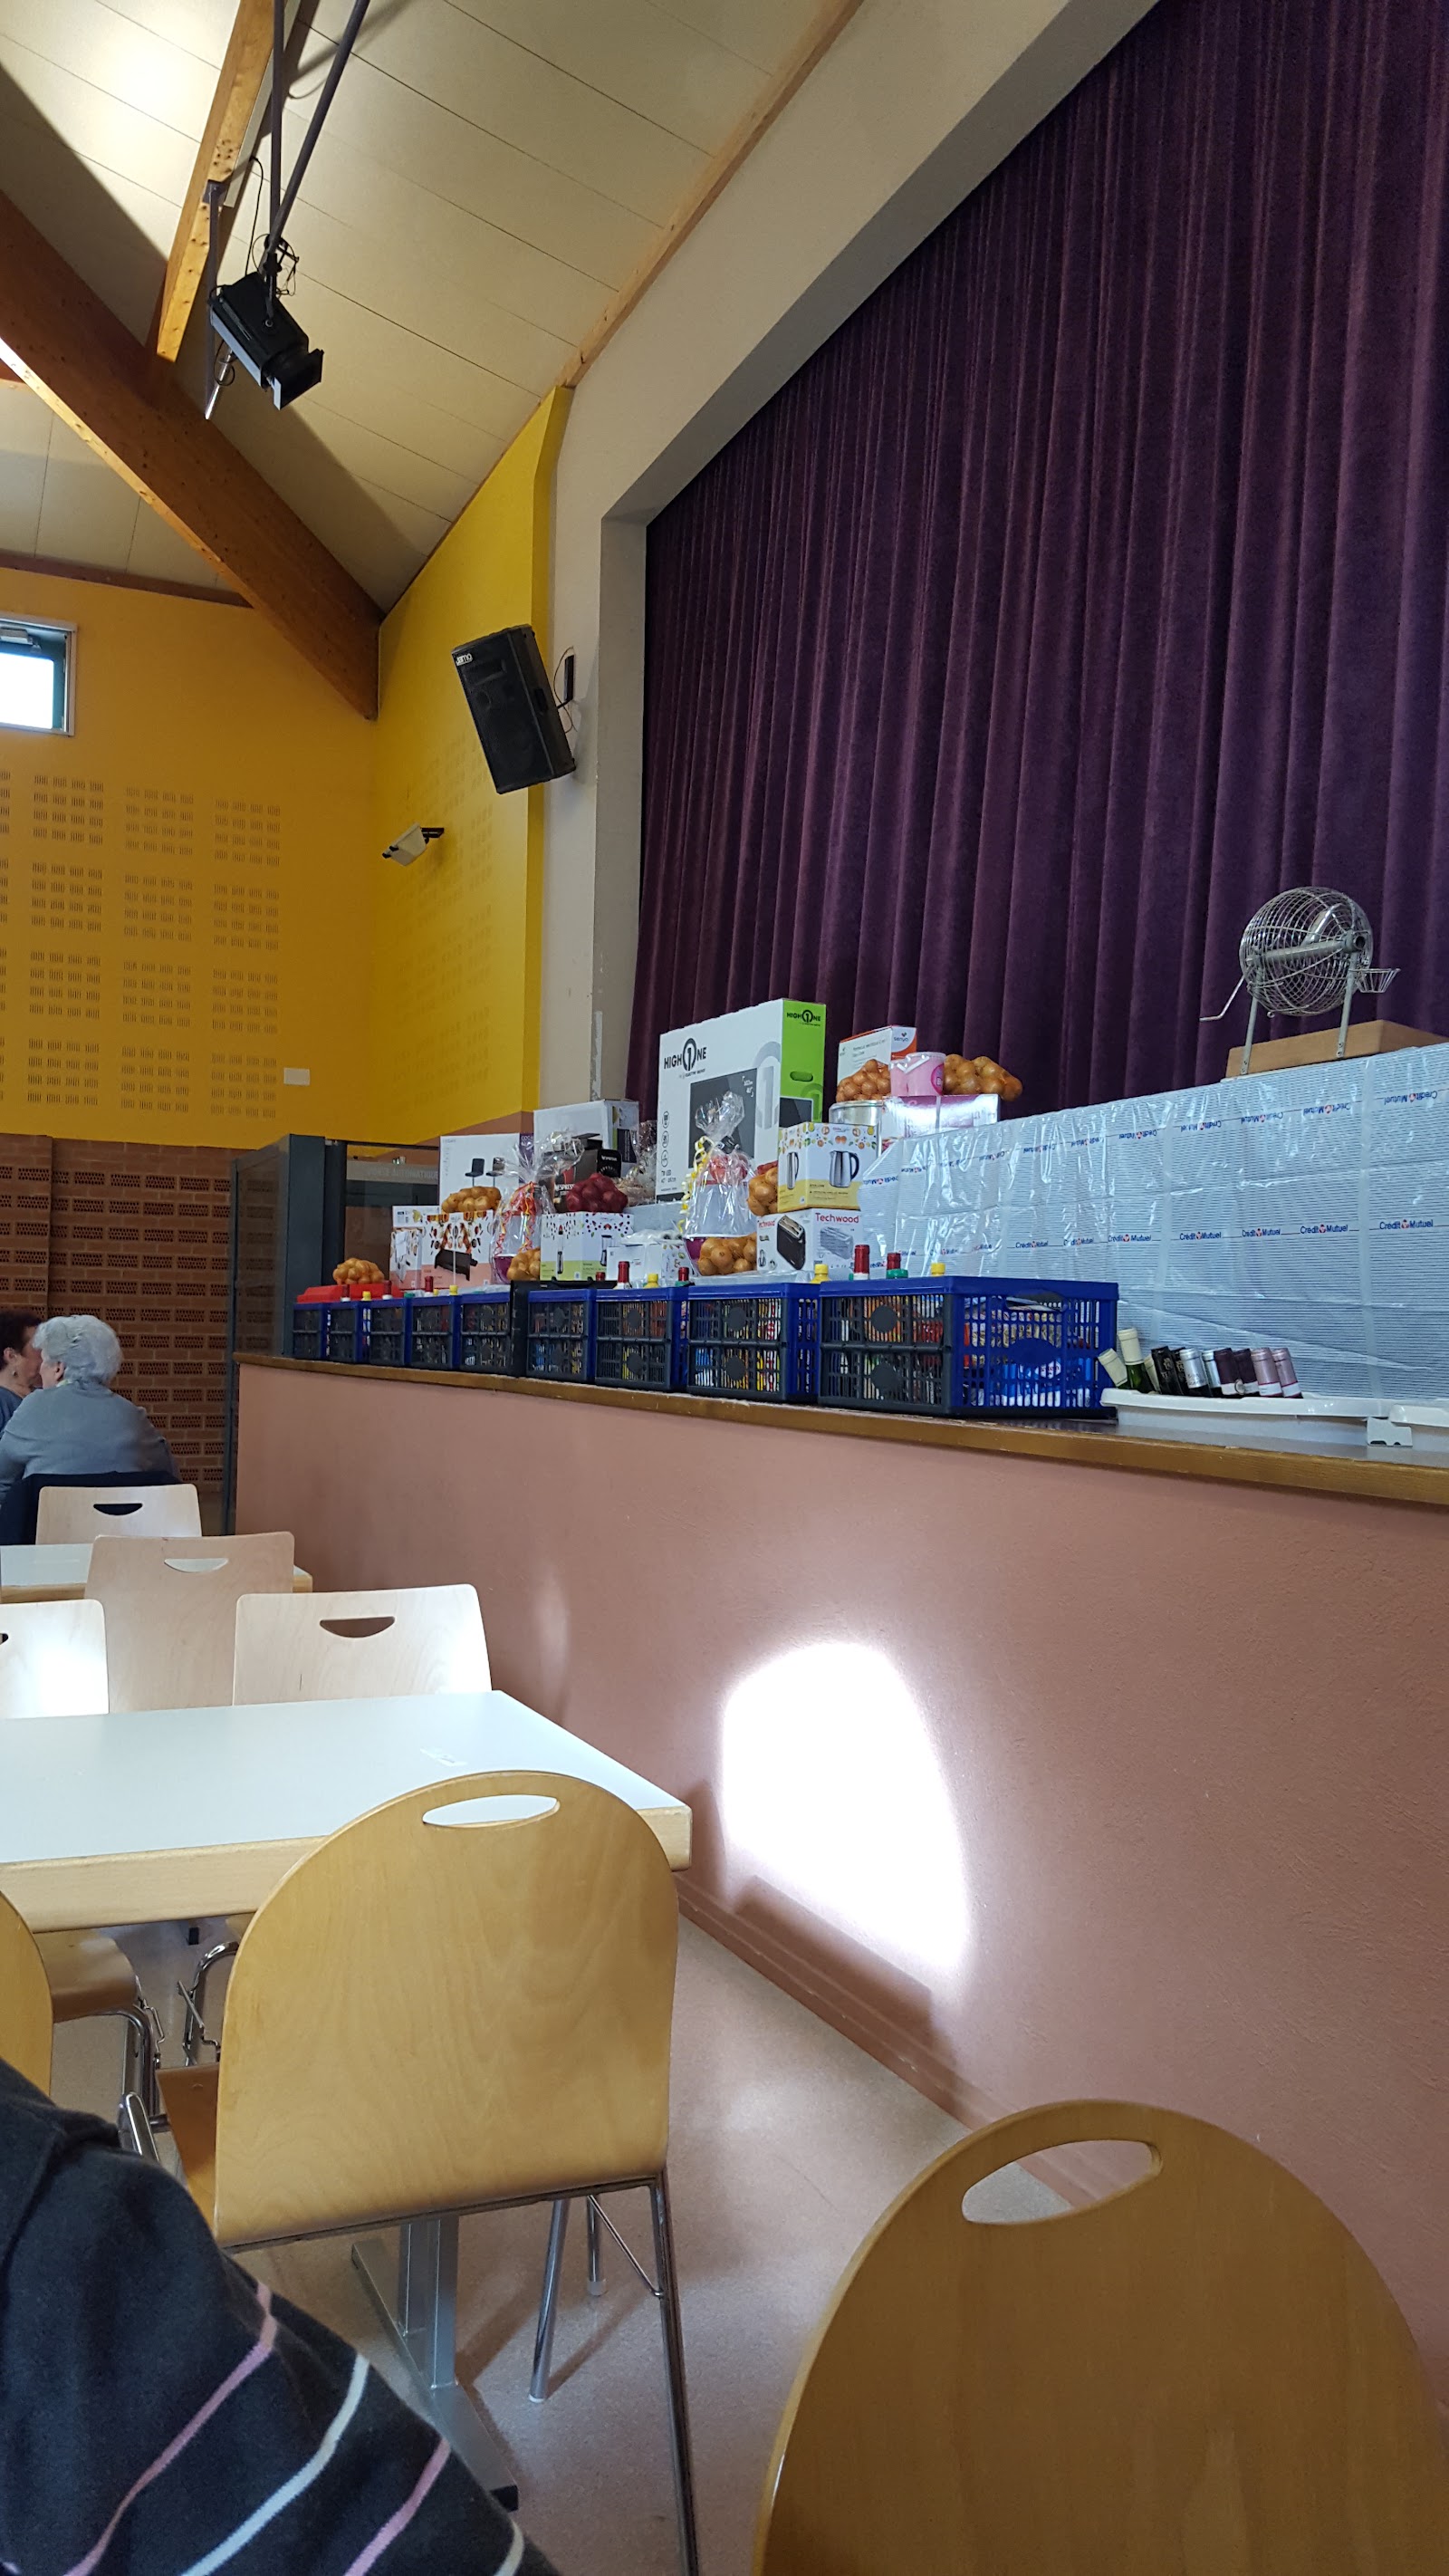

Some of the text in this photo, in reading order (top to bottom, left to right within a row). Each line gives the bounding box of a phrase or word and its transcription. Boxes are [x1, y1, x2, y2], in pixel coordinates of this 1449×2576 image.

[1384, 1095, 1408, 1105] Mutuel
[815, 1212, 859, 1223] Techwood
[1409, 1219, 1434, 1228] Mutuel
[1326, 1224, 1348, 1233] Mutuel
